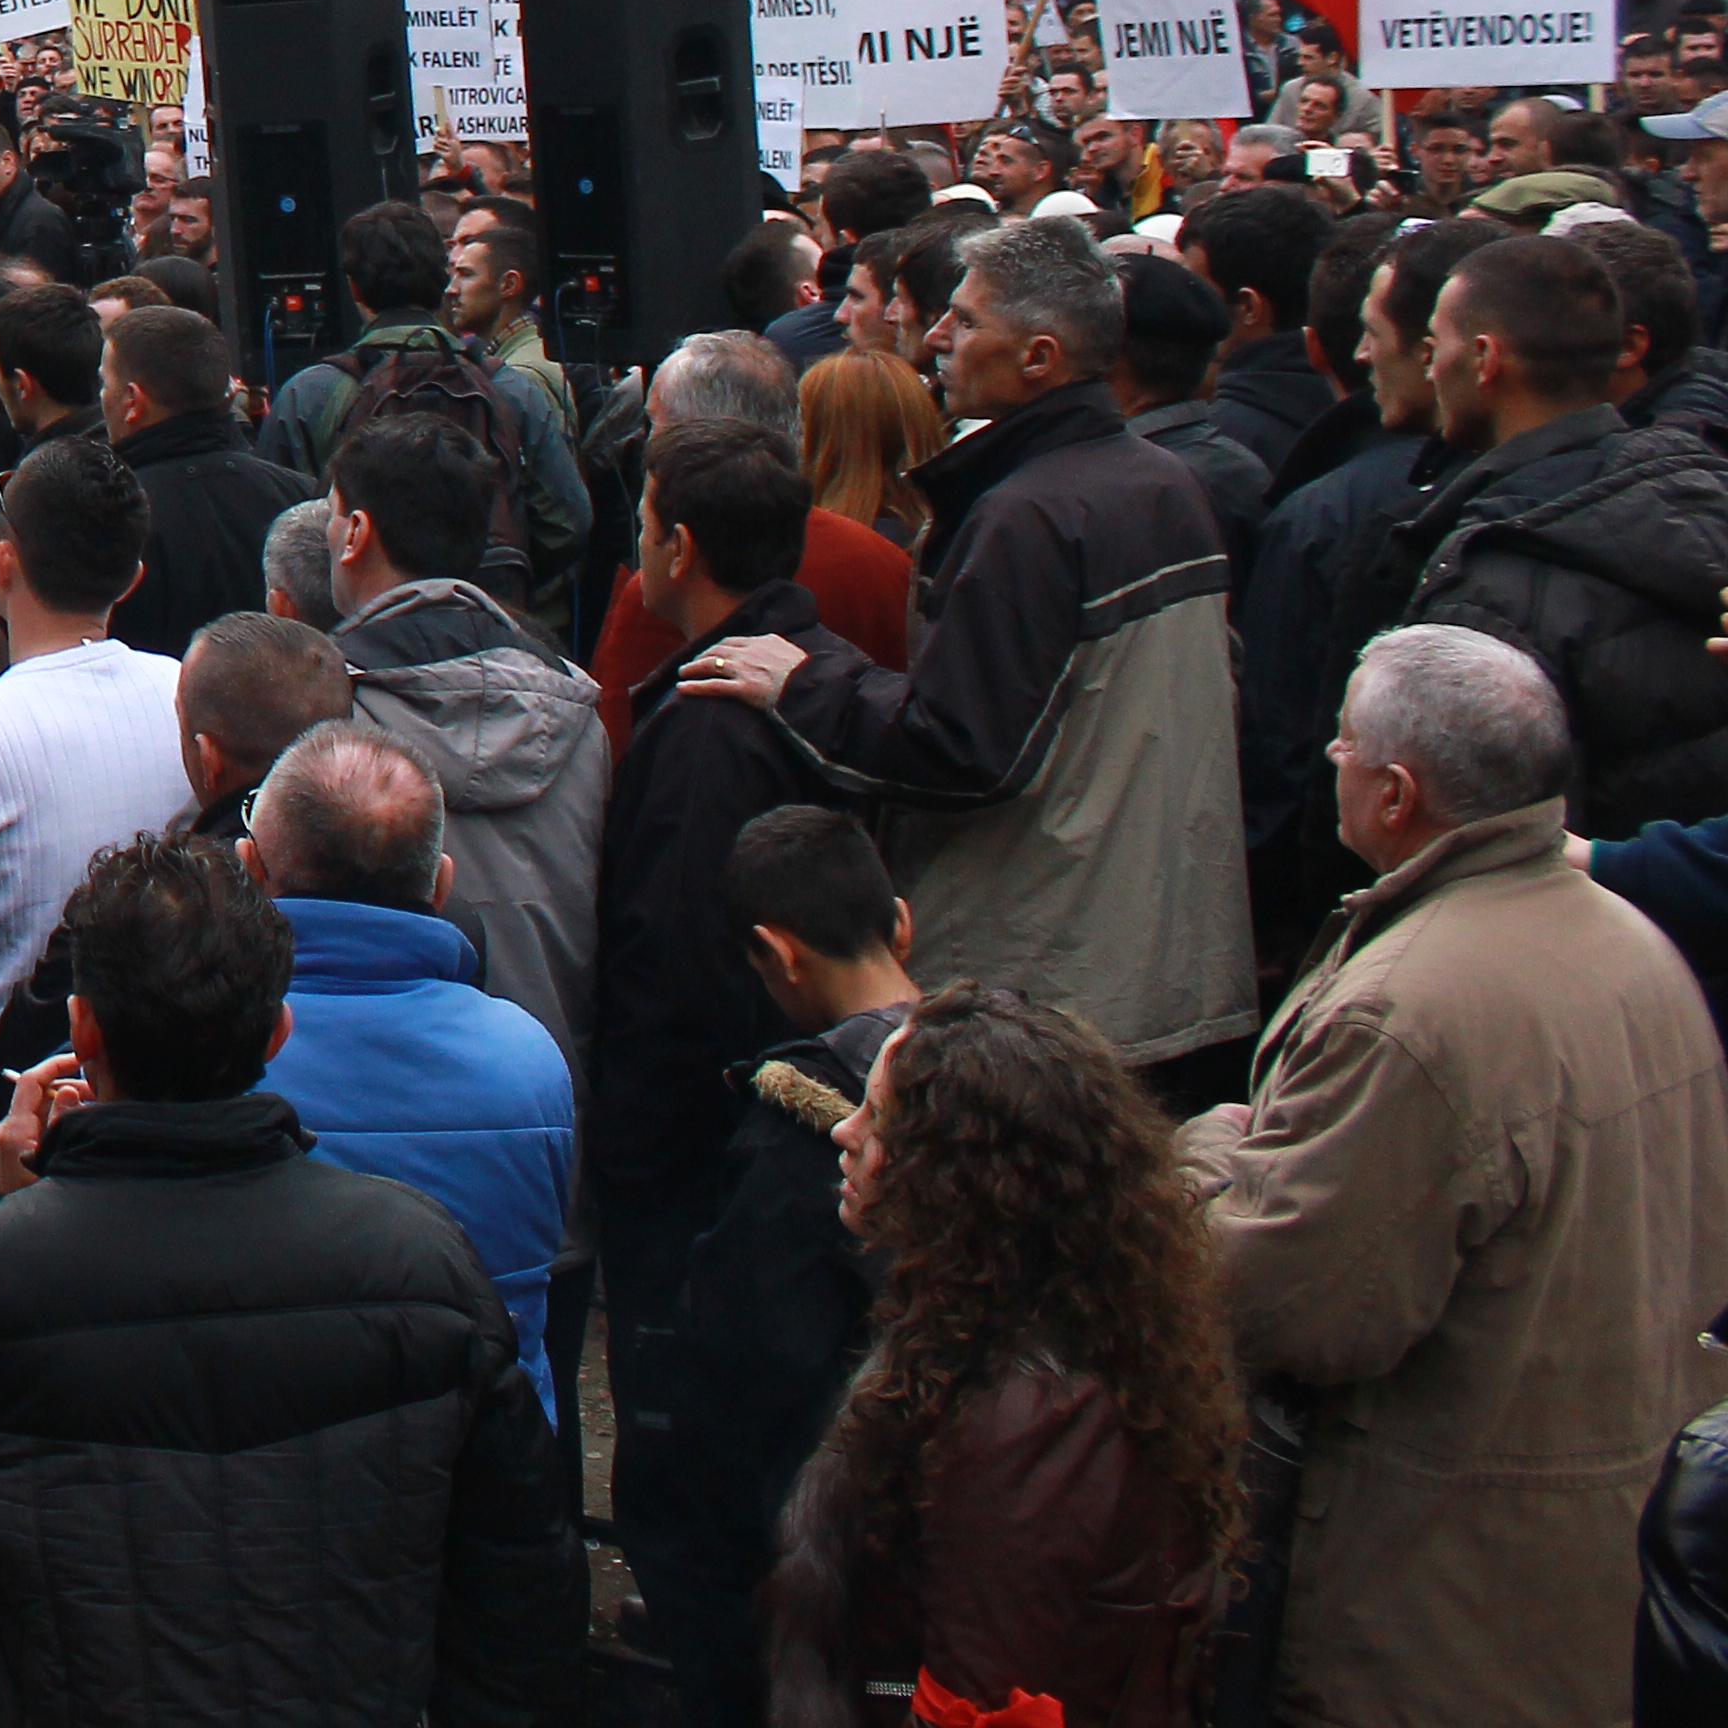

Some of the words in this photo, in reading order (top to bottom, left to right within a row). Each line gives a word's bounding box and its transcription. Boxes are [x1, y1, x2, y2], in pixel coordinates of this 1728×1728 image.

[406, 7, 478, 28] MINELËT
[1381, 10, 1594, 49] VETËVENDOSJE!
[73, 16, 192, 64] SURRENDER
[904, 15, 982, 61] NJË
[1114, 21, 1172, 59] JEMI
[1178, 9, 1231, 56] NJË
[422, 51, 480, 68] FALEN!
[77, 66, 112, 97] WE
[757, 98, 794, 121] NELËT
[759, 149, 792, 170] ALEN!
